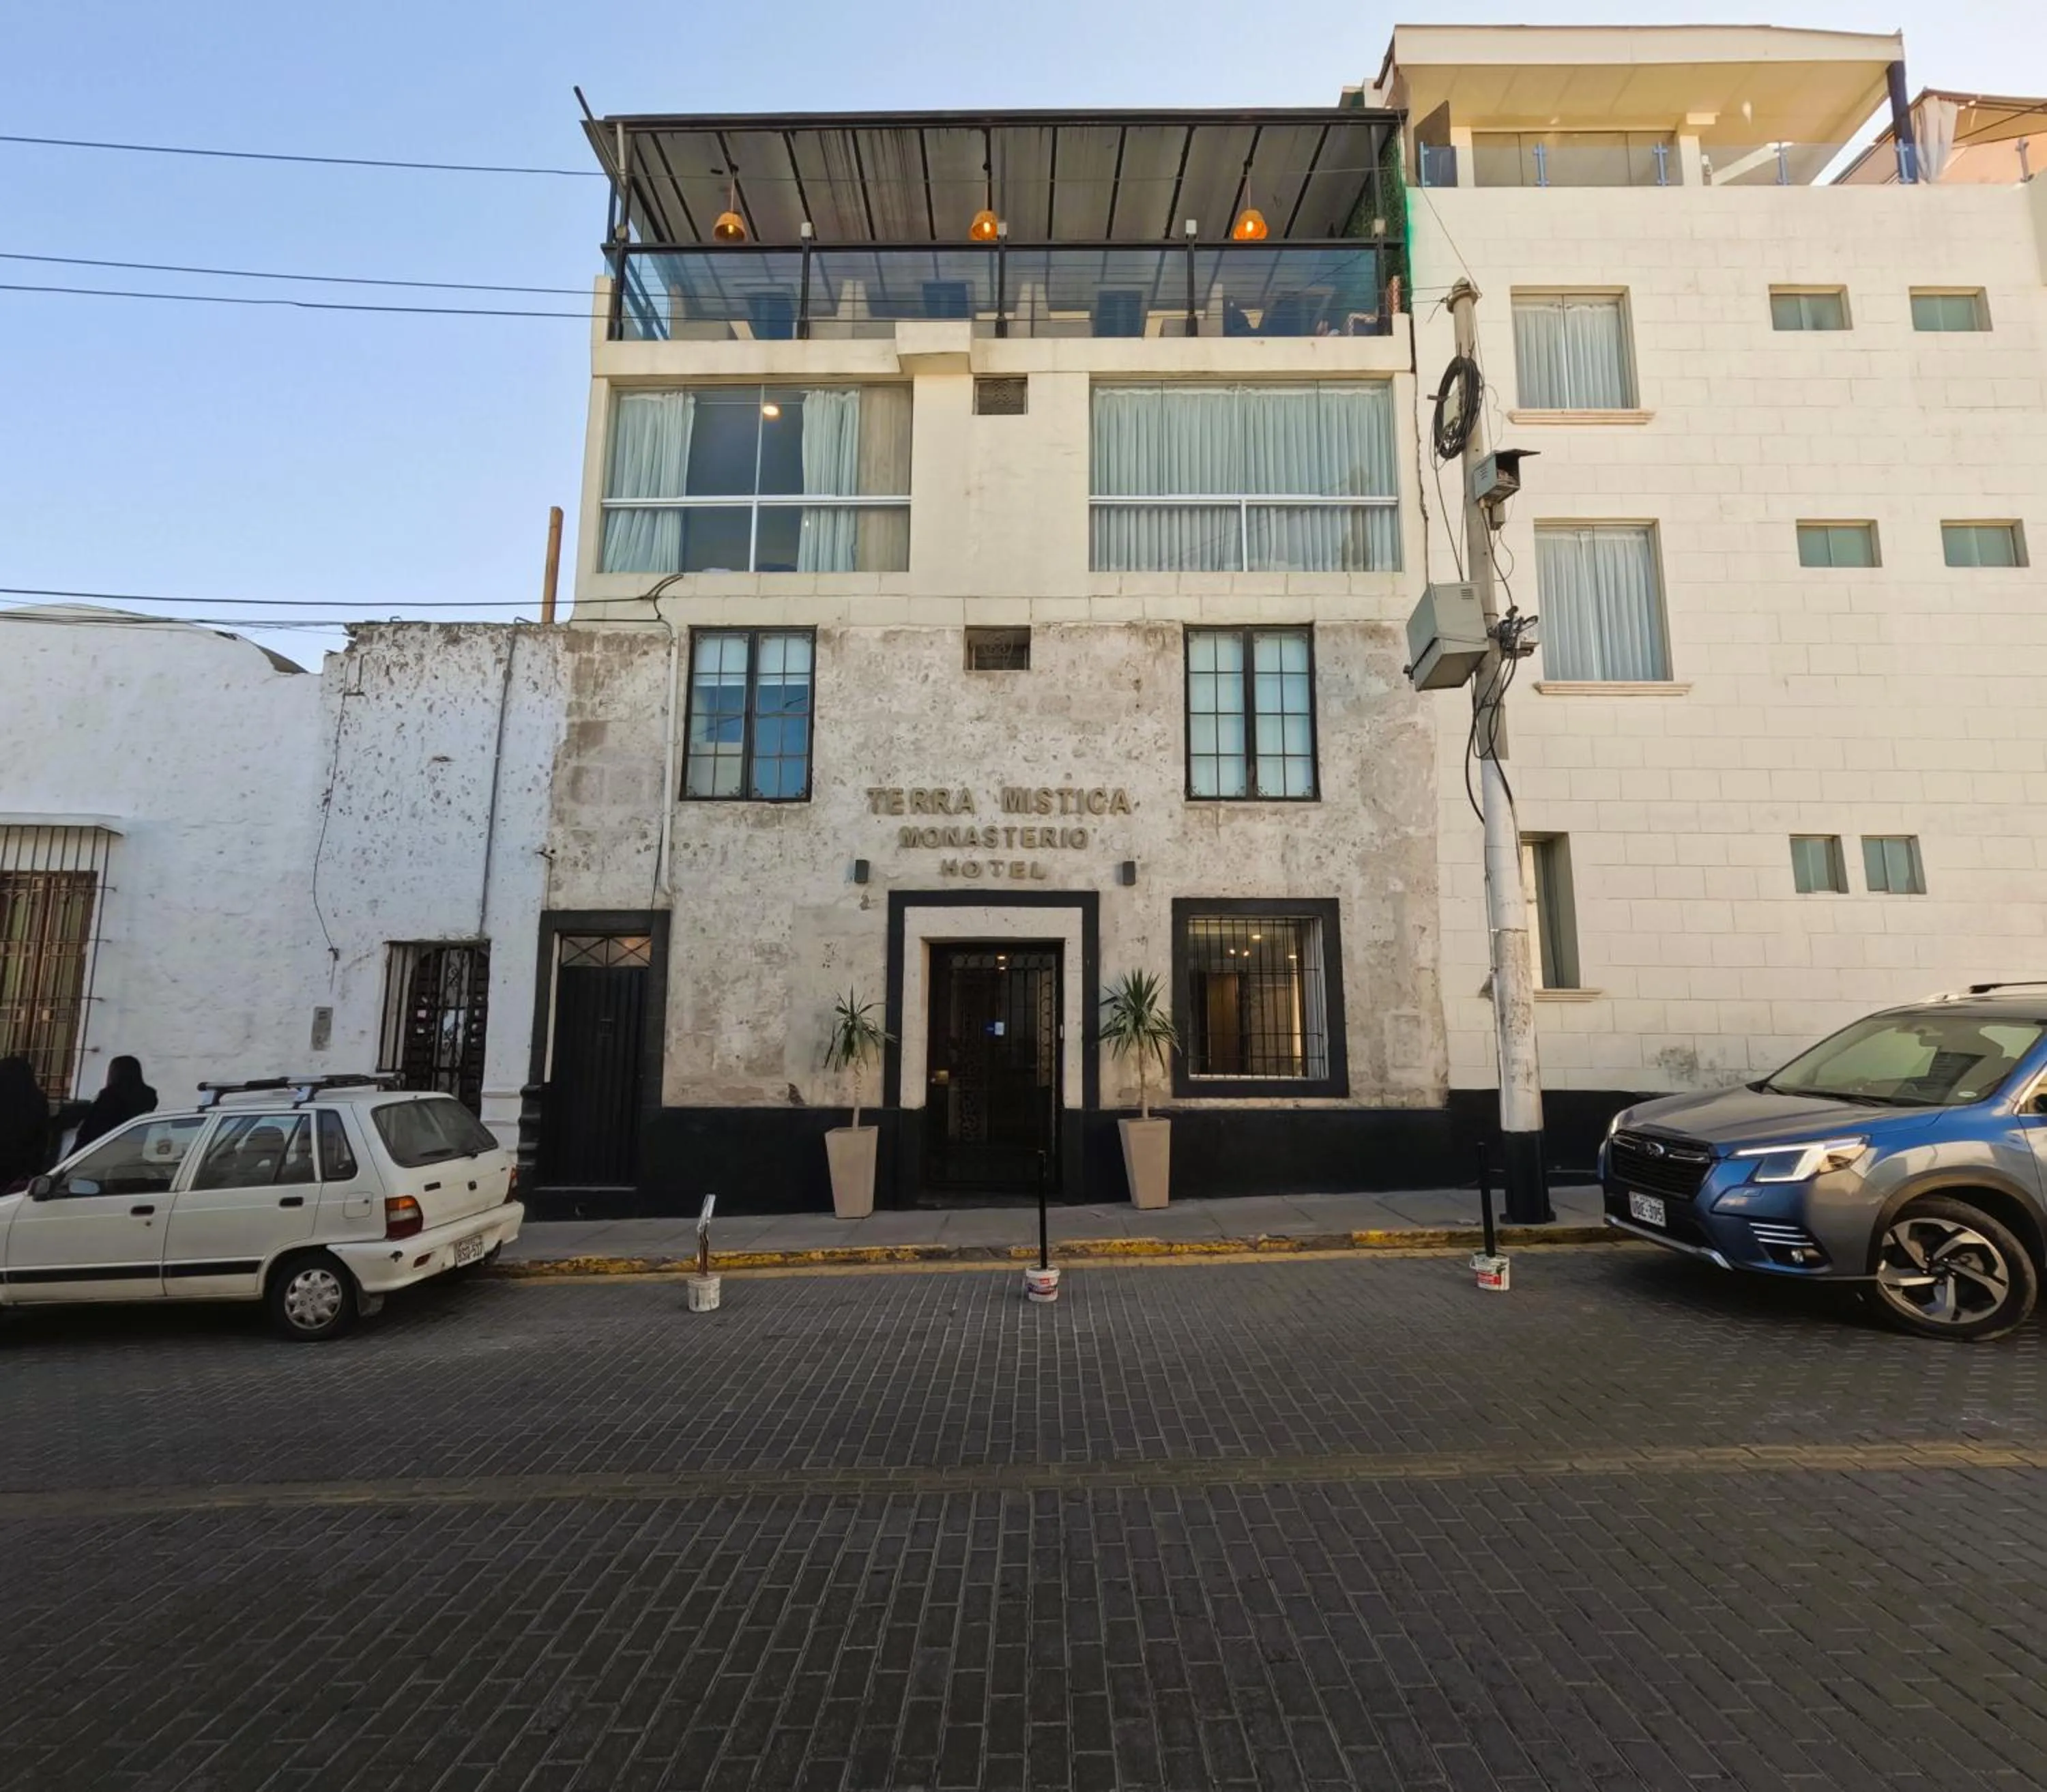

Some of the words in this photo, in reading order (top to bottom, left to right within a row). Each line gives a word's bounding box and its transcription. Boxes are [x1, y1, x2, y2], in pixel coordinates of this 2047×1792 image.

[867, 787, 976, 815] TERRA
[1001, 785, 1132, 815] MISTICA
[898, 825, 1089, 850] MONASTERIO
[939, 858, 1048, 880] HOTEL
